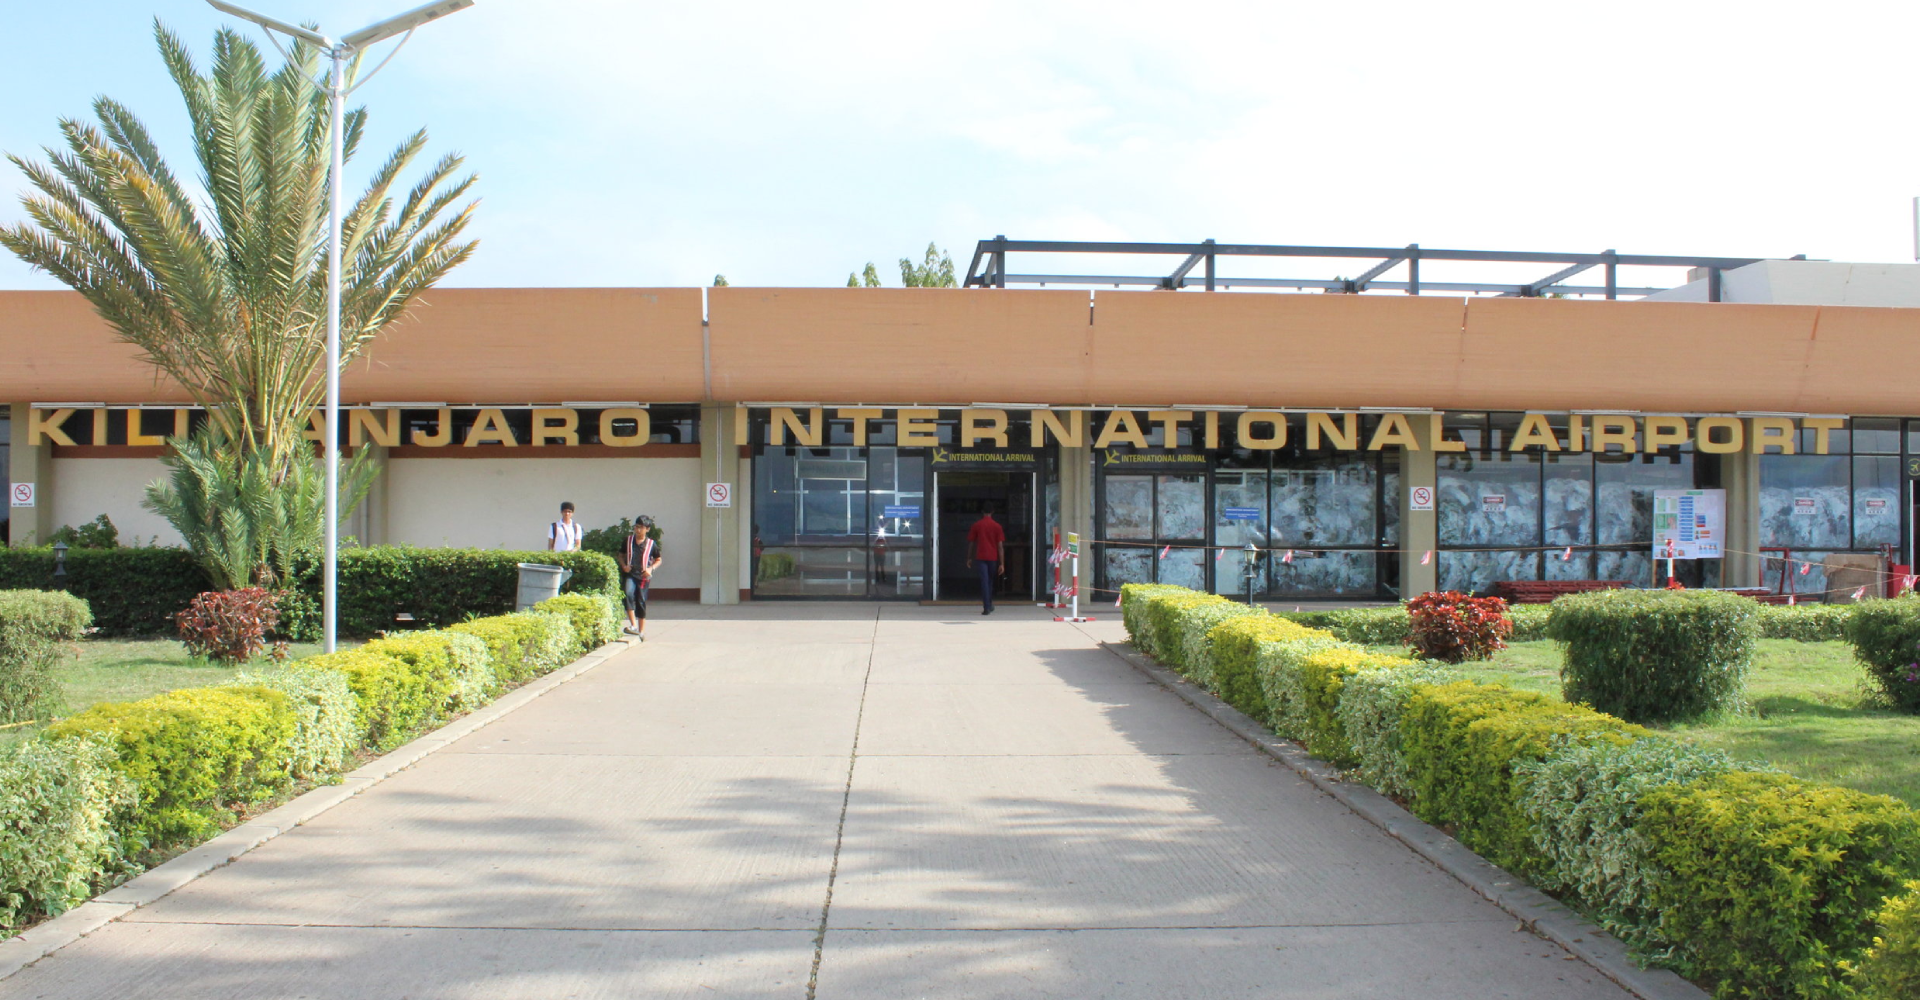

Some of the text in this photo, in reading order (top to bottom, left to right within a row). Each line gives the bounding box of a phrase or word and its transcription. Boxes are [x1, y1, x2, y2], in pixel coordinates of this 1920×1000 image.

[735, 407, 1467, 452] INTERNATIONAL
[1508, 414, 1845, 455] AIRPORT
[948, 453, 1035, 462] INTERNATIONAL ARRIVAL
[1121, 454, 1206, 463] INTERNATIONAL ARRIVAL
